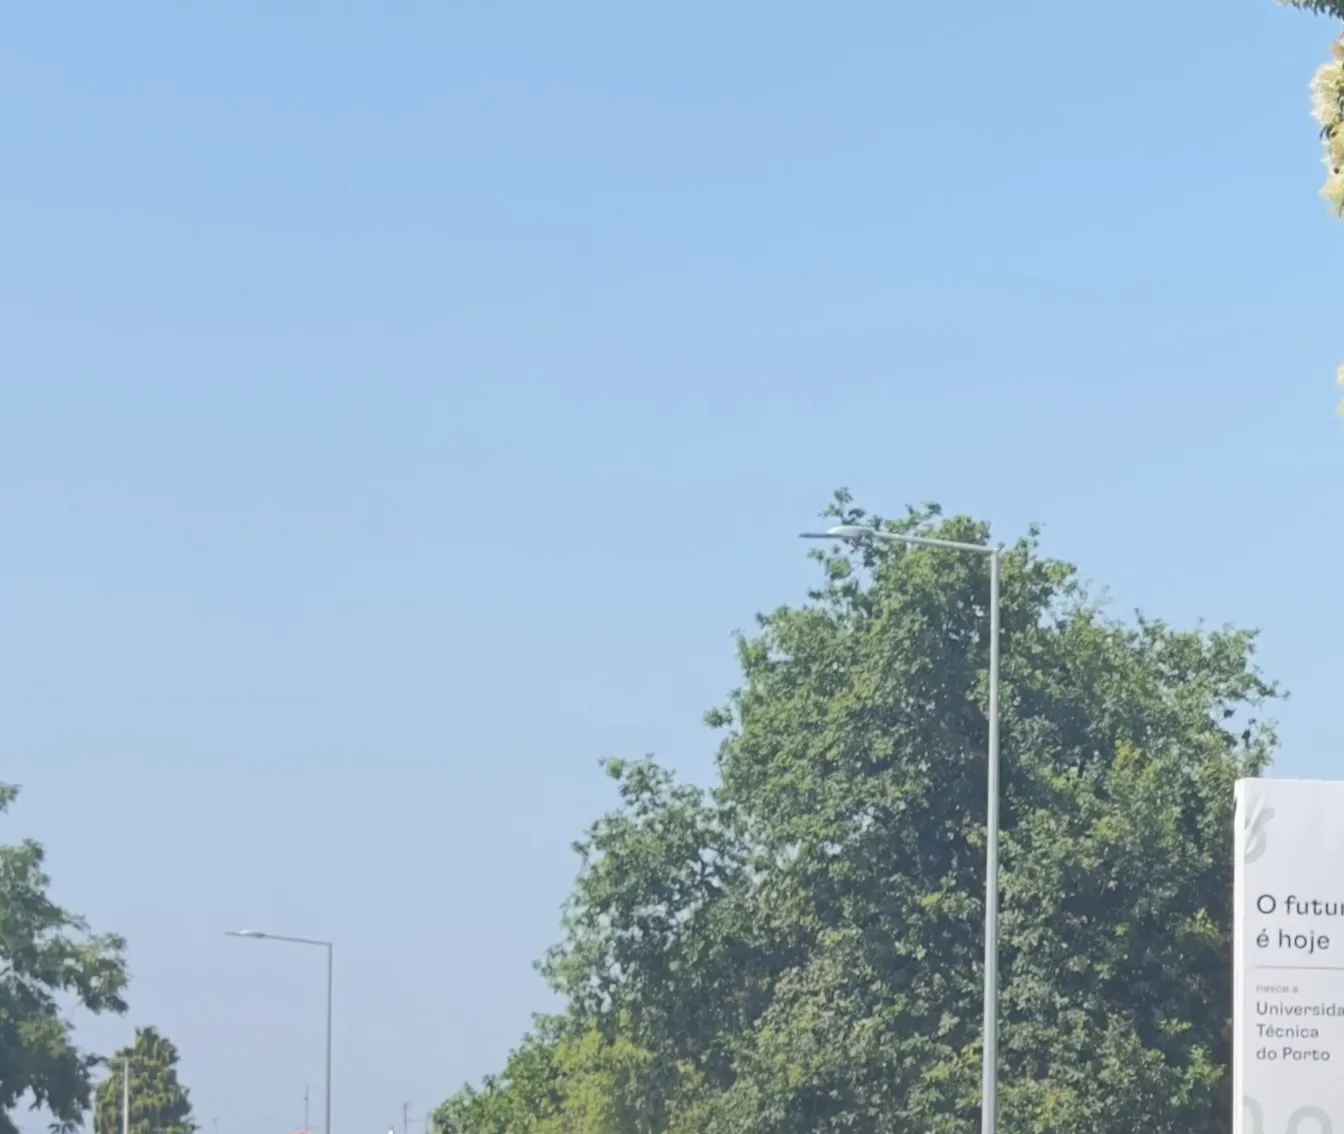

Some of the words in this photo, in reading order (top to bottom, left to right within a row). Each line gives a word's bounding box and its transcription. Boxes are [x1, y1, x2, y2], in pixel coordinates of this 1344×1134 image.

[1256, 894, 1276, 914] O
[1256, 928, 1269, 948] é
[1278, 928, 1330, 954] hoje
[1256, 1023, 1319, 1038] Técnica
[1256, 1046, 1277, 1061] do
[1282, 1046, 1331, 1061] Porto
